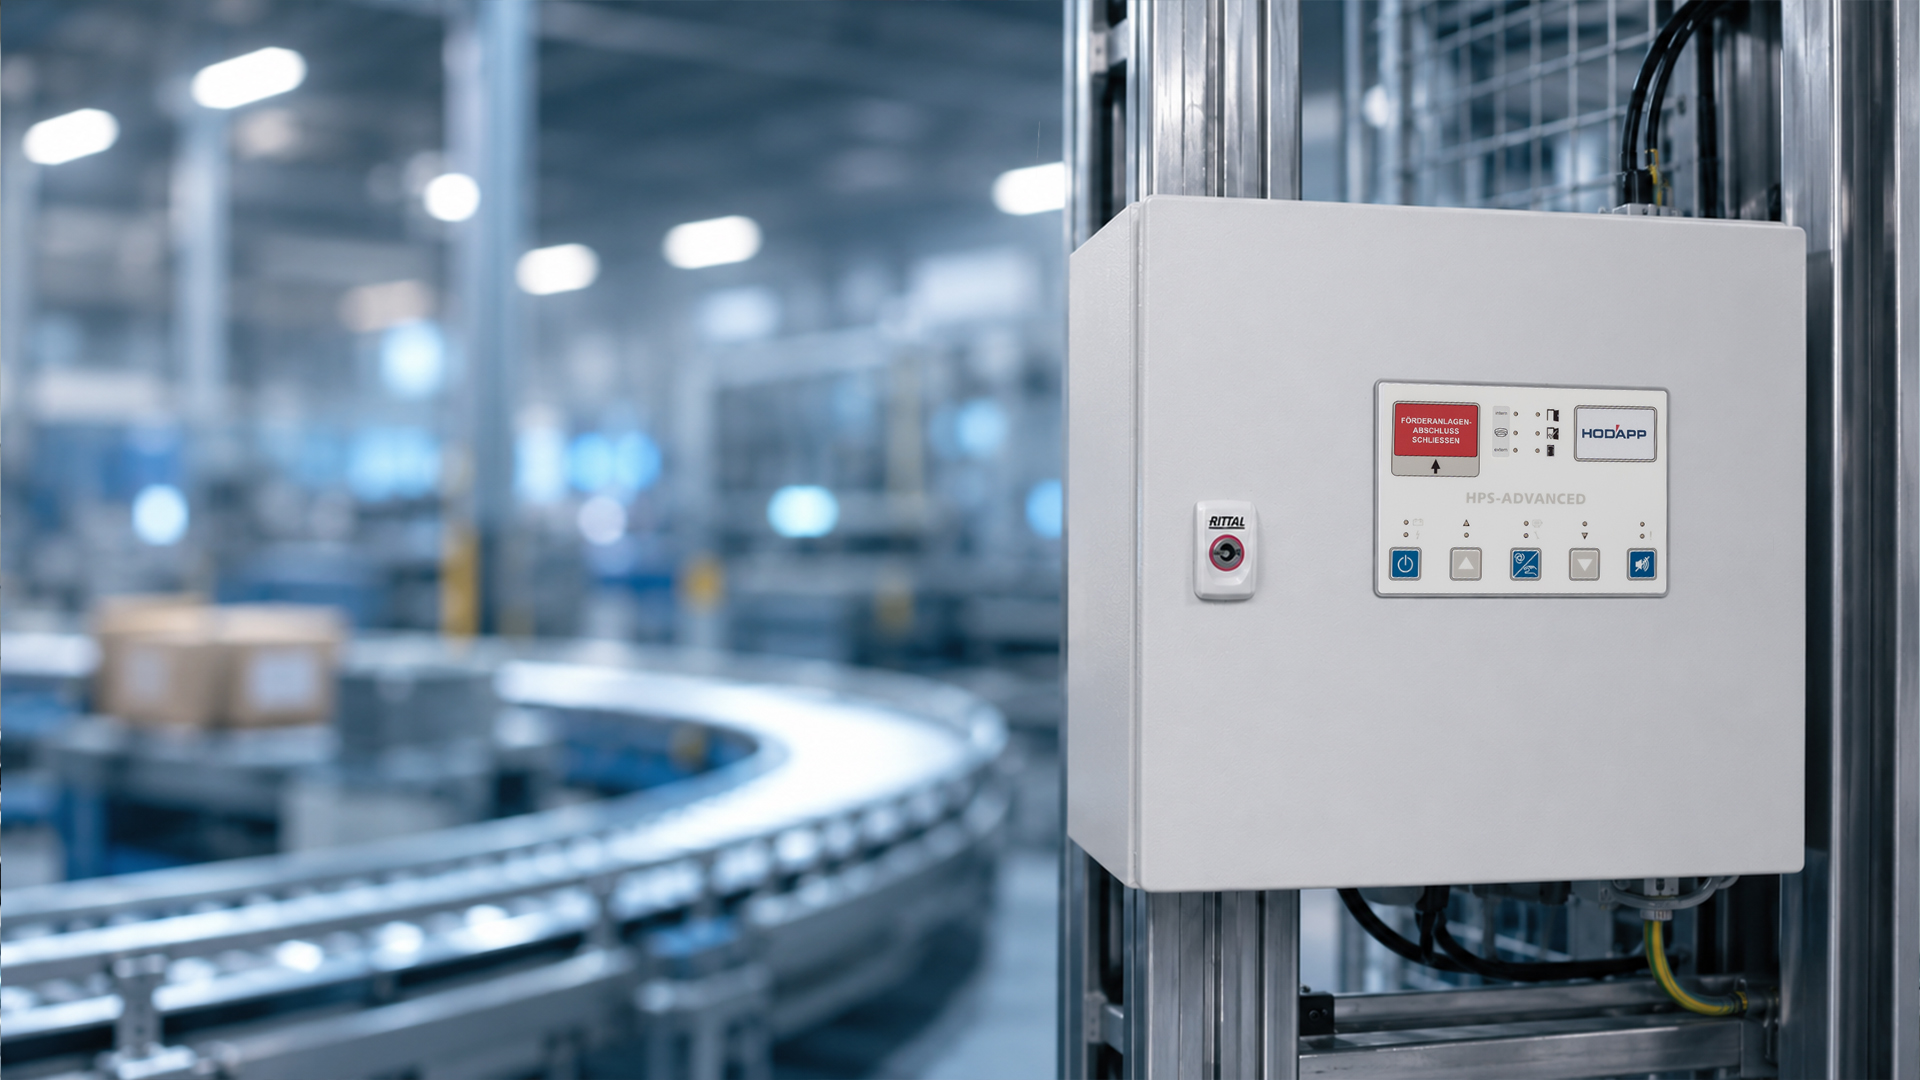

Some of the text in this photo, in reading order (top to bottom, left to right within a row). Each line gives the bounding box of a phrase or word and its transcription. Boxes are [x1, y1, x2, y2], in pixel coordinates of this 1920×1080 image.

[1401, 416, 1472, 425] FÖRDERANLAGEN-
[1412, 427, 1460, 435] ABSCHLUSS
[1581, 427, 1647, 440] HODAPP
[1412, 436, 1460, 444] SCHLIESSEN
[1466, 492, 1587, 505] HPS-ADVANCED
[1209, 516, 1246, 527] RITTAL
